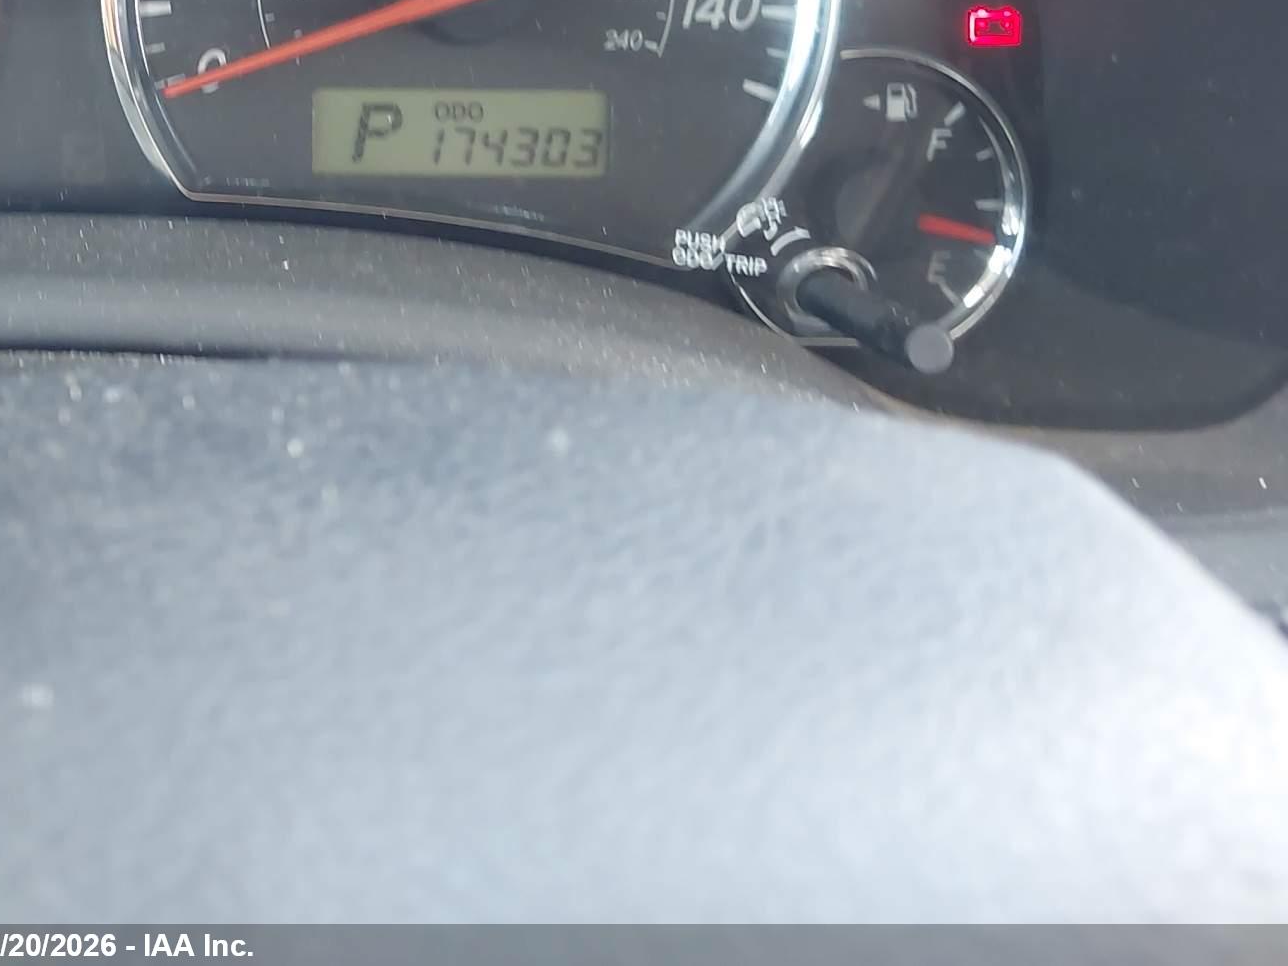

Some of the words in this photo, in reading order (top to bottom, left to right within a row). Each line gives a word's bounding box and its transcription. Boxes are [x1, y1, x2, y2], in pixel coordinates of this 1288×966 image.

[604, 30, 644, 51] 240
[434, 101, 484, 122] ODO
[351, 102, 403, 162] P
[432, 126, 603, 167] 174303
[926, 128, 952, 161] F
[675, 229, 726, 254] PUSH
[927, 250, 952, 284] E
